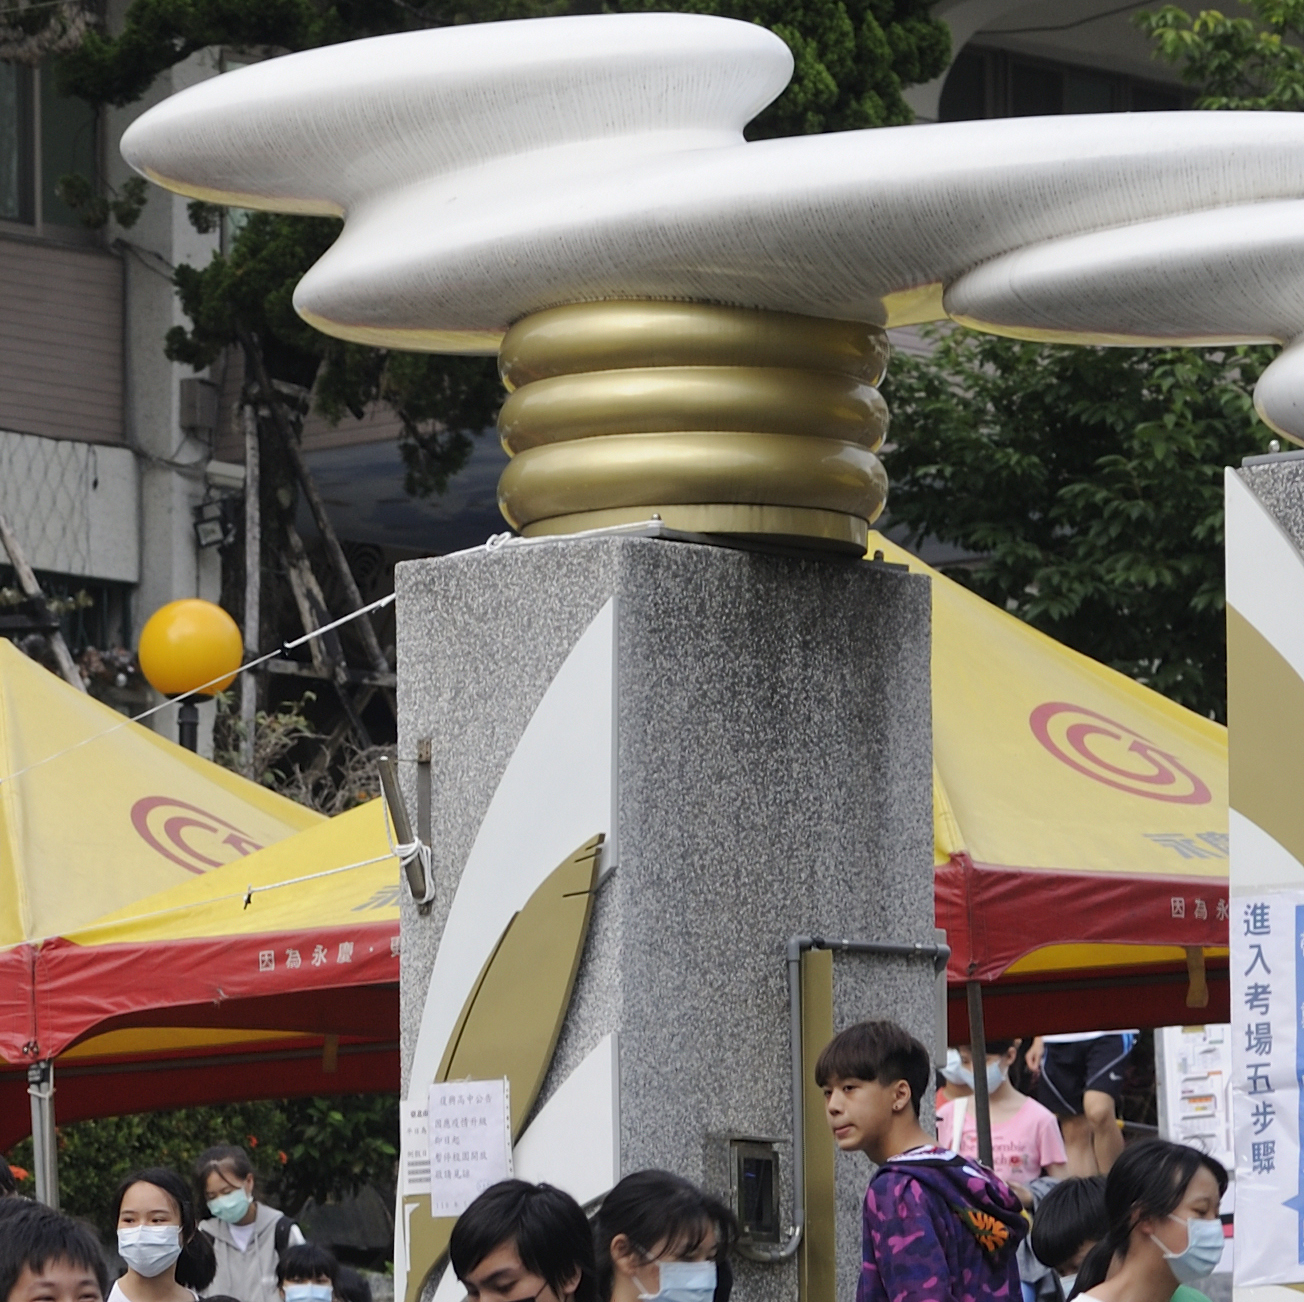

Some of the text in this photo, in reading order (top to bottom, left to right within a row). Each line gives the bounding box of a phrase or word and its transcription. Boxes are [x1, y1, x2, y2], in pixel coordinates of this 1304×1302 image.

[1243, 901, 1277, 1176] 進入考場五步驟
